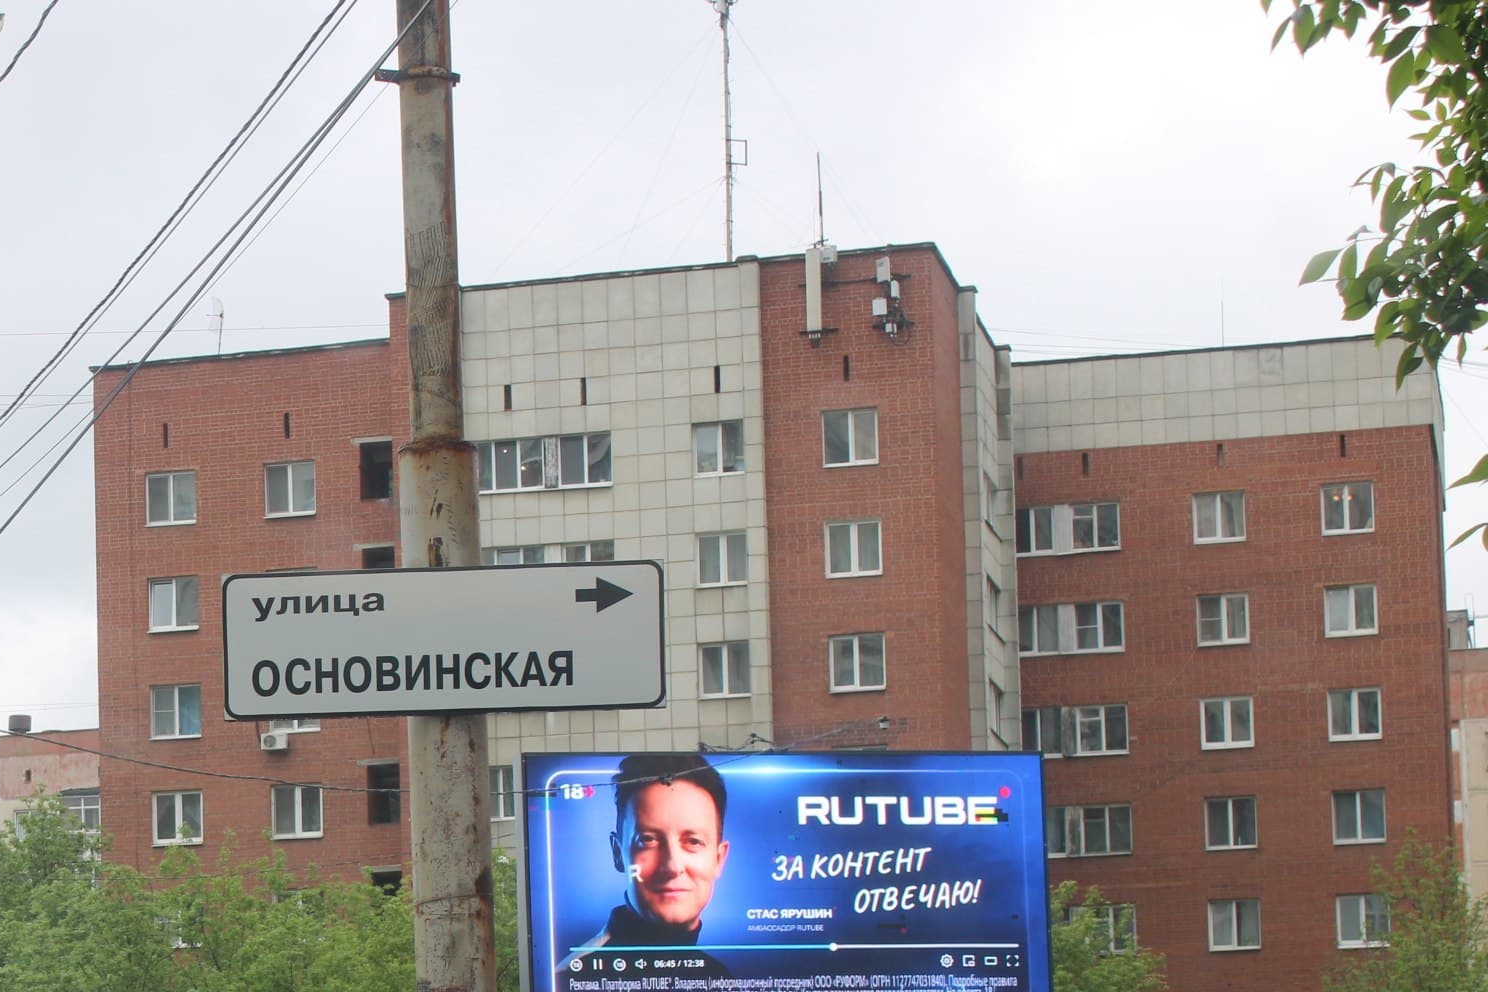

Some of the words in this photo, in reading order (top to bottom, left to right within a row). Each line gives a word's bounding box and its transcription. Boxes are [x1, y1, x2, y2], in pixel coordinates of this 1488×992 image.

[252, 591, 385, 622] улица
[252, 650, 574, 697] ОСНОВИНСКАЯ
[797, 796, 999, 825] RUTUBE
[771, 855, 804, 881] ЗА
[810, 847, 932, 879] КОНТЕНТ
[854, 879, 982, 913] ОТВЕЧАЮ!
[746, 908, 778, 919] СТАС
[780, 908, 833, 919] ЯРУШИН
[797, 924, 824, 932] RUTUBE
[654, 959, 676, 968] 06:45
[684, 959, 704, 968] 12:38
